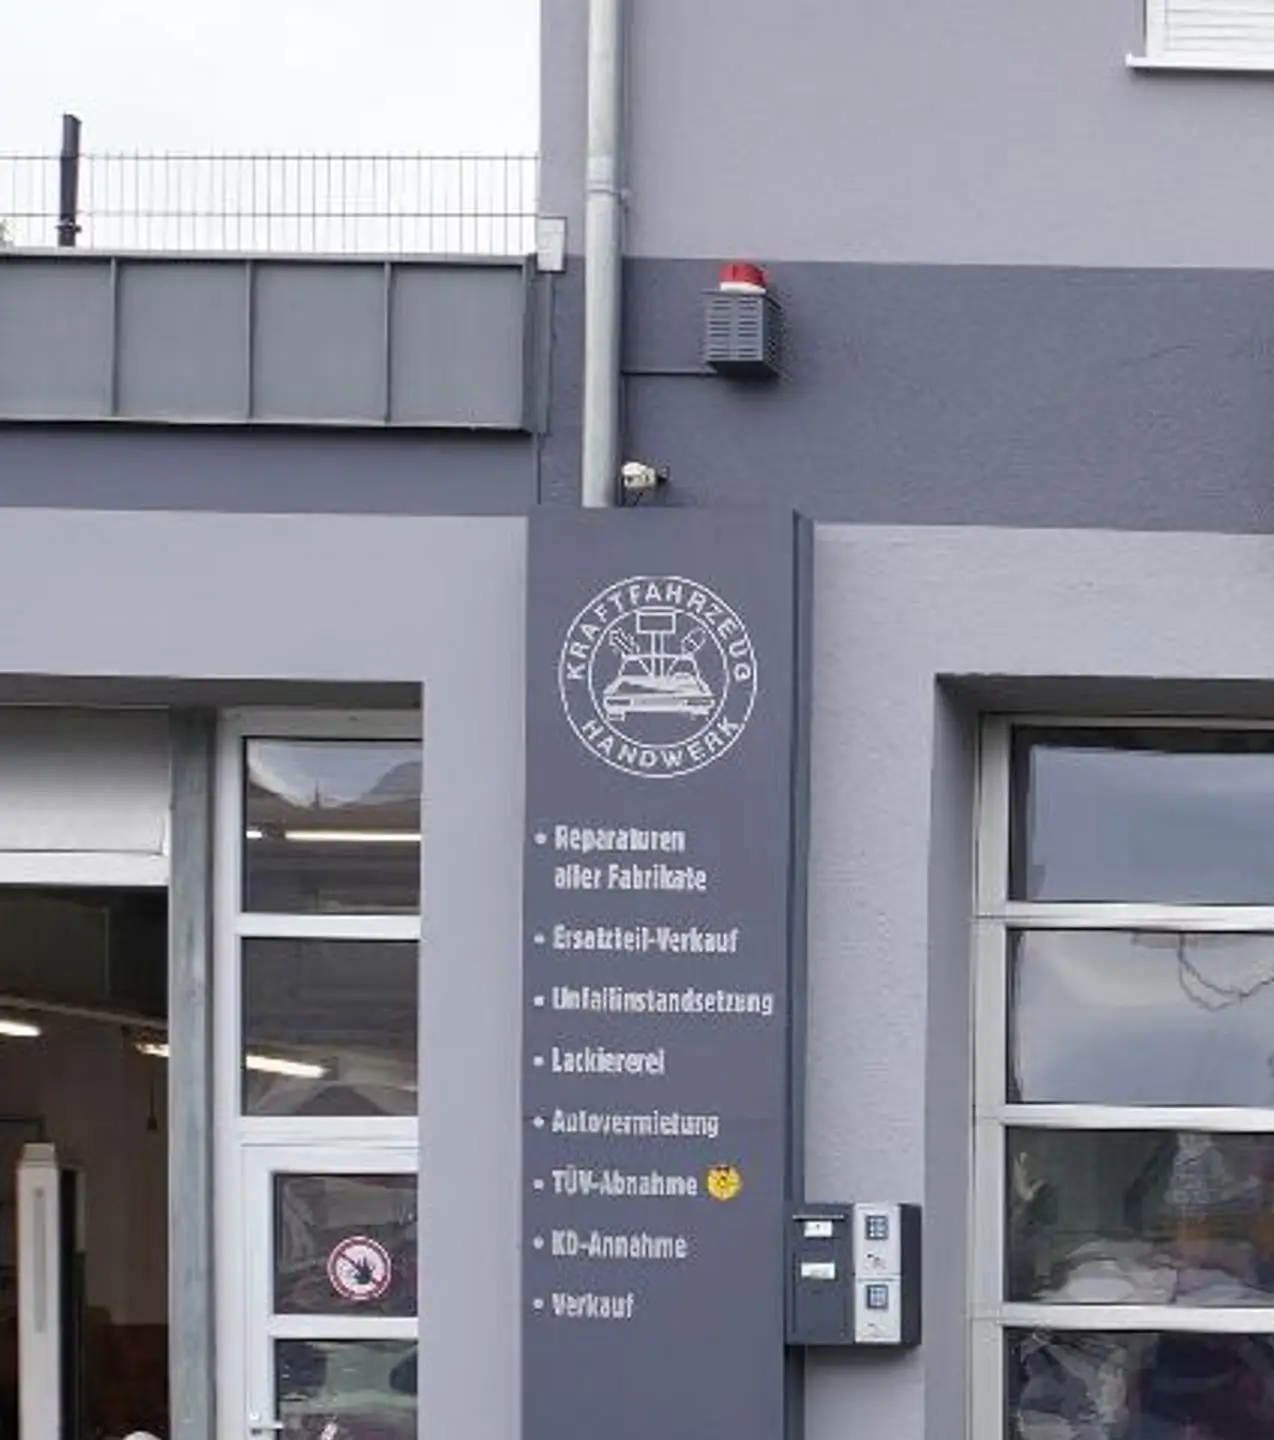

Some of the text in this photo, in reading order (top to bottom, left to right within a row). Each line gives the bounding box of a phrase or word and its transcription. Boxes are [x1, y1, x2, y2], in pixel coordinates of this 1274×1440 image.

[566, 581, 752, 683] KRAFTFAHRZEUG
[581, 717, 740, 767] HANDWERK
[556, 826, 684, 852] Reparaturen
[555, 864, 707, 891] aller Fabrikate
[554, 925, 738, 952] Ersatzteil-Verkauf
[553, 987, 773, 1015] Unfallinstandsetzung
[553, 1047, 664, 1074] Lackiererei
[553, 1110, 718, 1138] Autovermietung
[552, 1165, 697, 1195] TÜV-Abnahme
[552, 1230, 687, 1258] KD-Annahme
[553, 1293, 633, 1317] Verkauf
